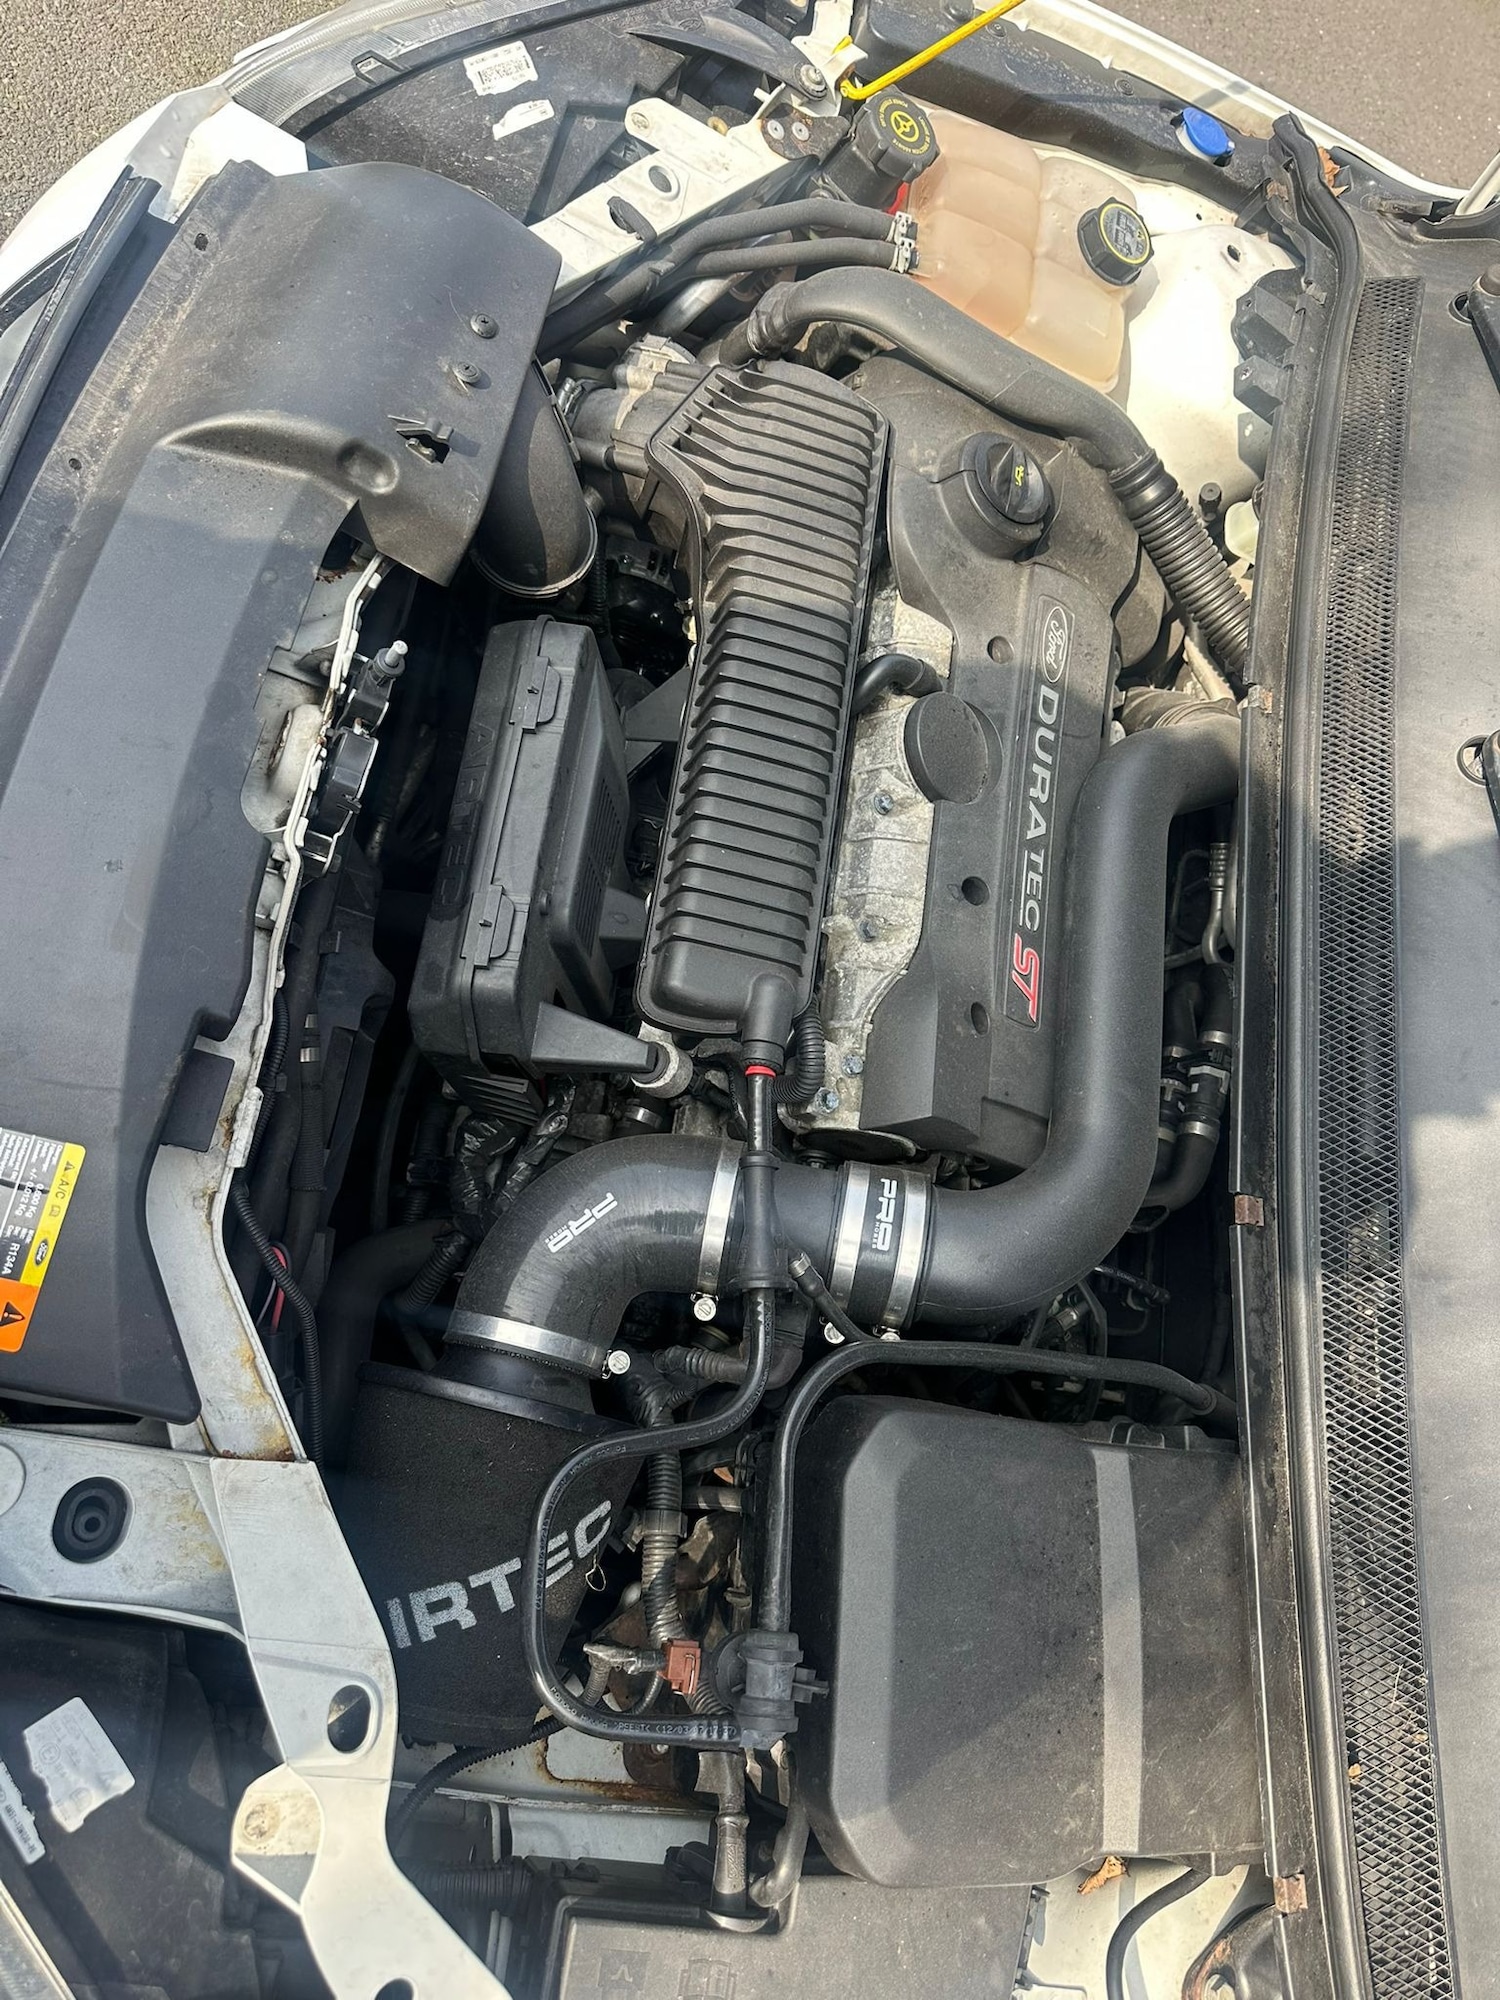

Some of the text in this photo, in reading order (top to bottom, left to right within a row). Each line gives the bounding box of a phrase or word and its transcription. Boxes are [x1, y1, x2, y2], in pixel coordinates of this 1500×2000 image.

[1011, 620, 1066, 1023] Ford DURATEC ST
[55, 1178, 70, 1200] A/C
[547, 1192, 618, 1253] PRO
[876, 1178, 898, 1251] PRO
[1, 1242, 21, 1275] R134A
[384, 1500, 612, 1649] IRTEC
